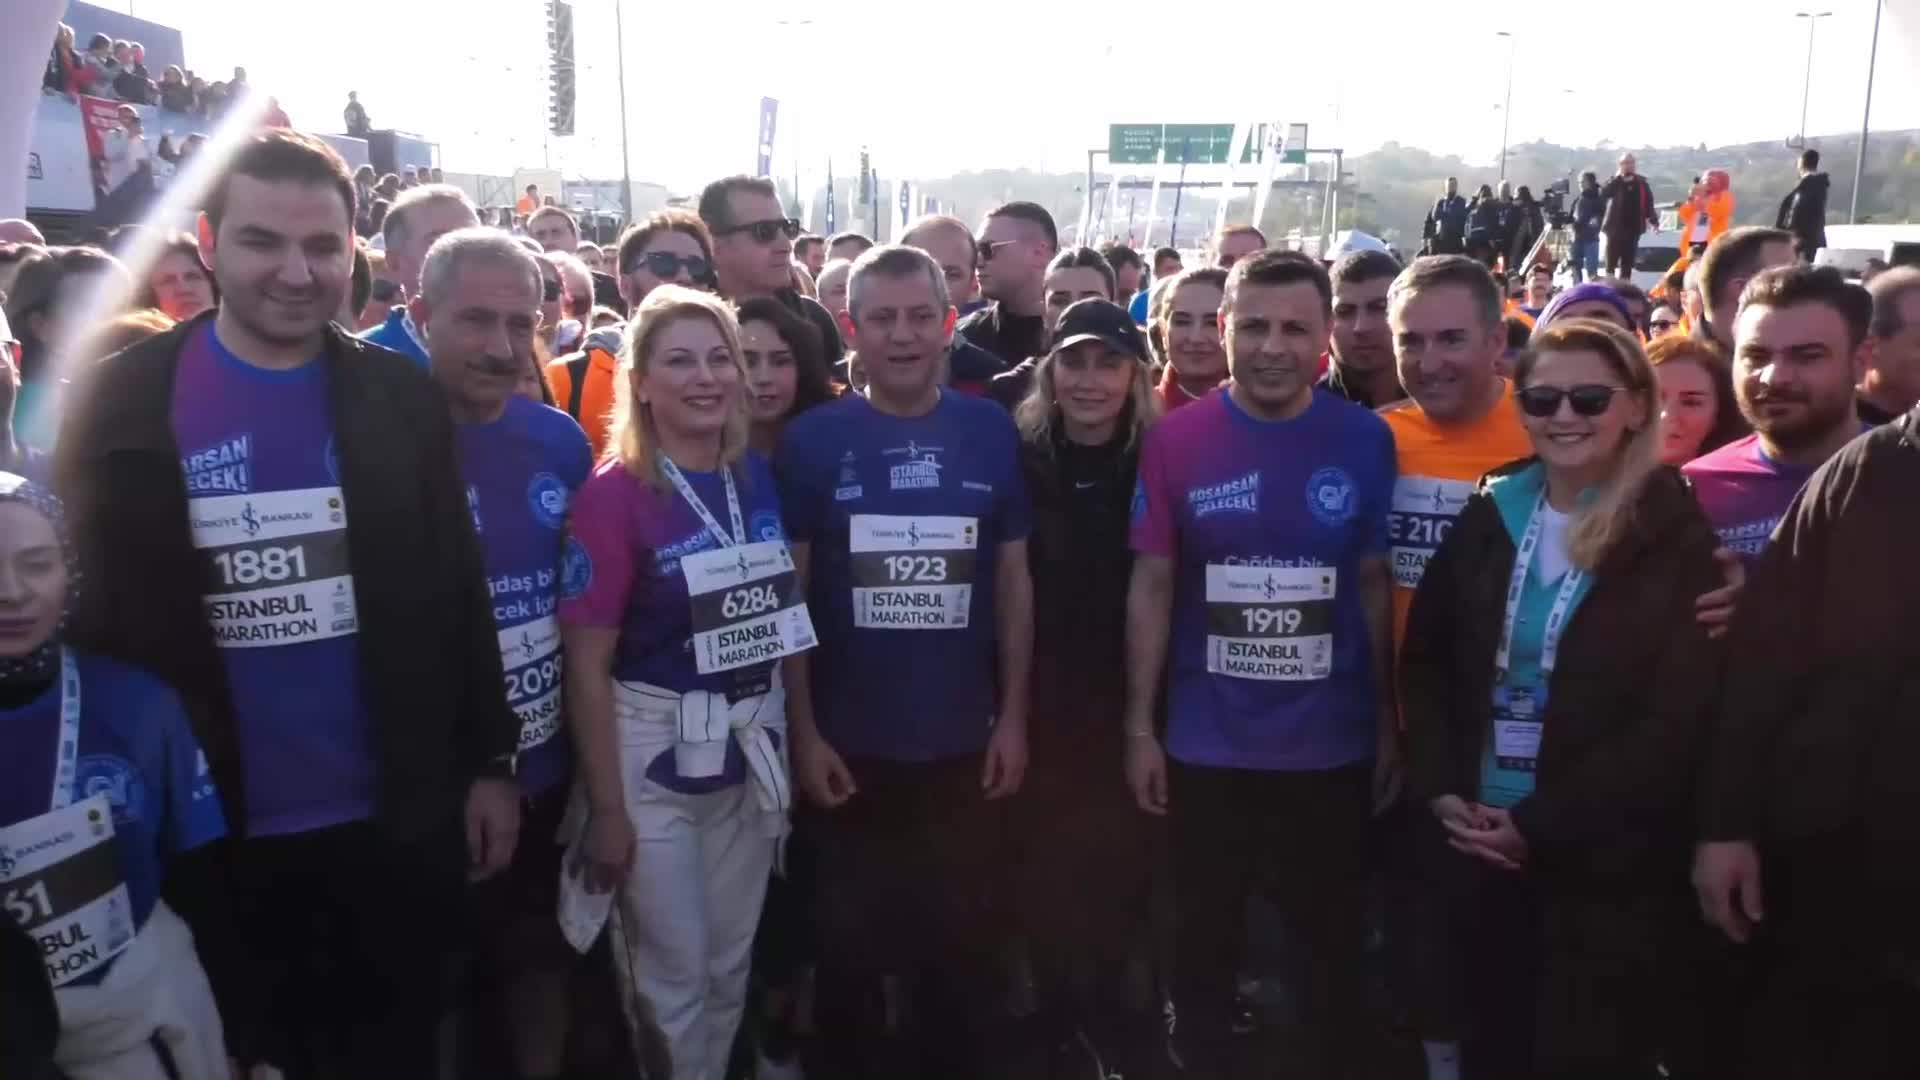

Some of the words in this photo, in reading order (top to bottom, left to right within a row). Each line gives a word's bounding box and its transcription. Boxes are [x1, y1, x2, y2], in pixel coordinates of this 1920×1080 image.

[213, 545, 307, 585] 1881
[883, 556, 947, 581] 1923
[722, 584, 780, 619] 6284
[872, 591, 945, 608] ISTANBUL
[213, 618, 317, 642] MARATHON
[871, 611, 945, 625] MARATHON
[1242, 607, 1302, 633] 1919
[718, 621, 780, 648] ISTANBUL
[718, 640, 785, 666] MARATHON
[1227, 642, 1302, 659] ISTANBUL
[1226, 659, 1304, 676] MARATHON
[40, 921, 91, 955] BUL
